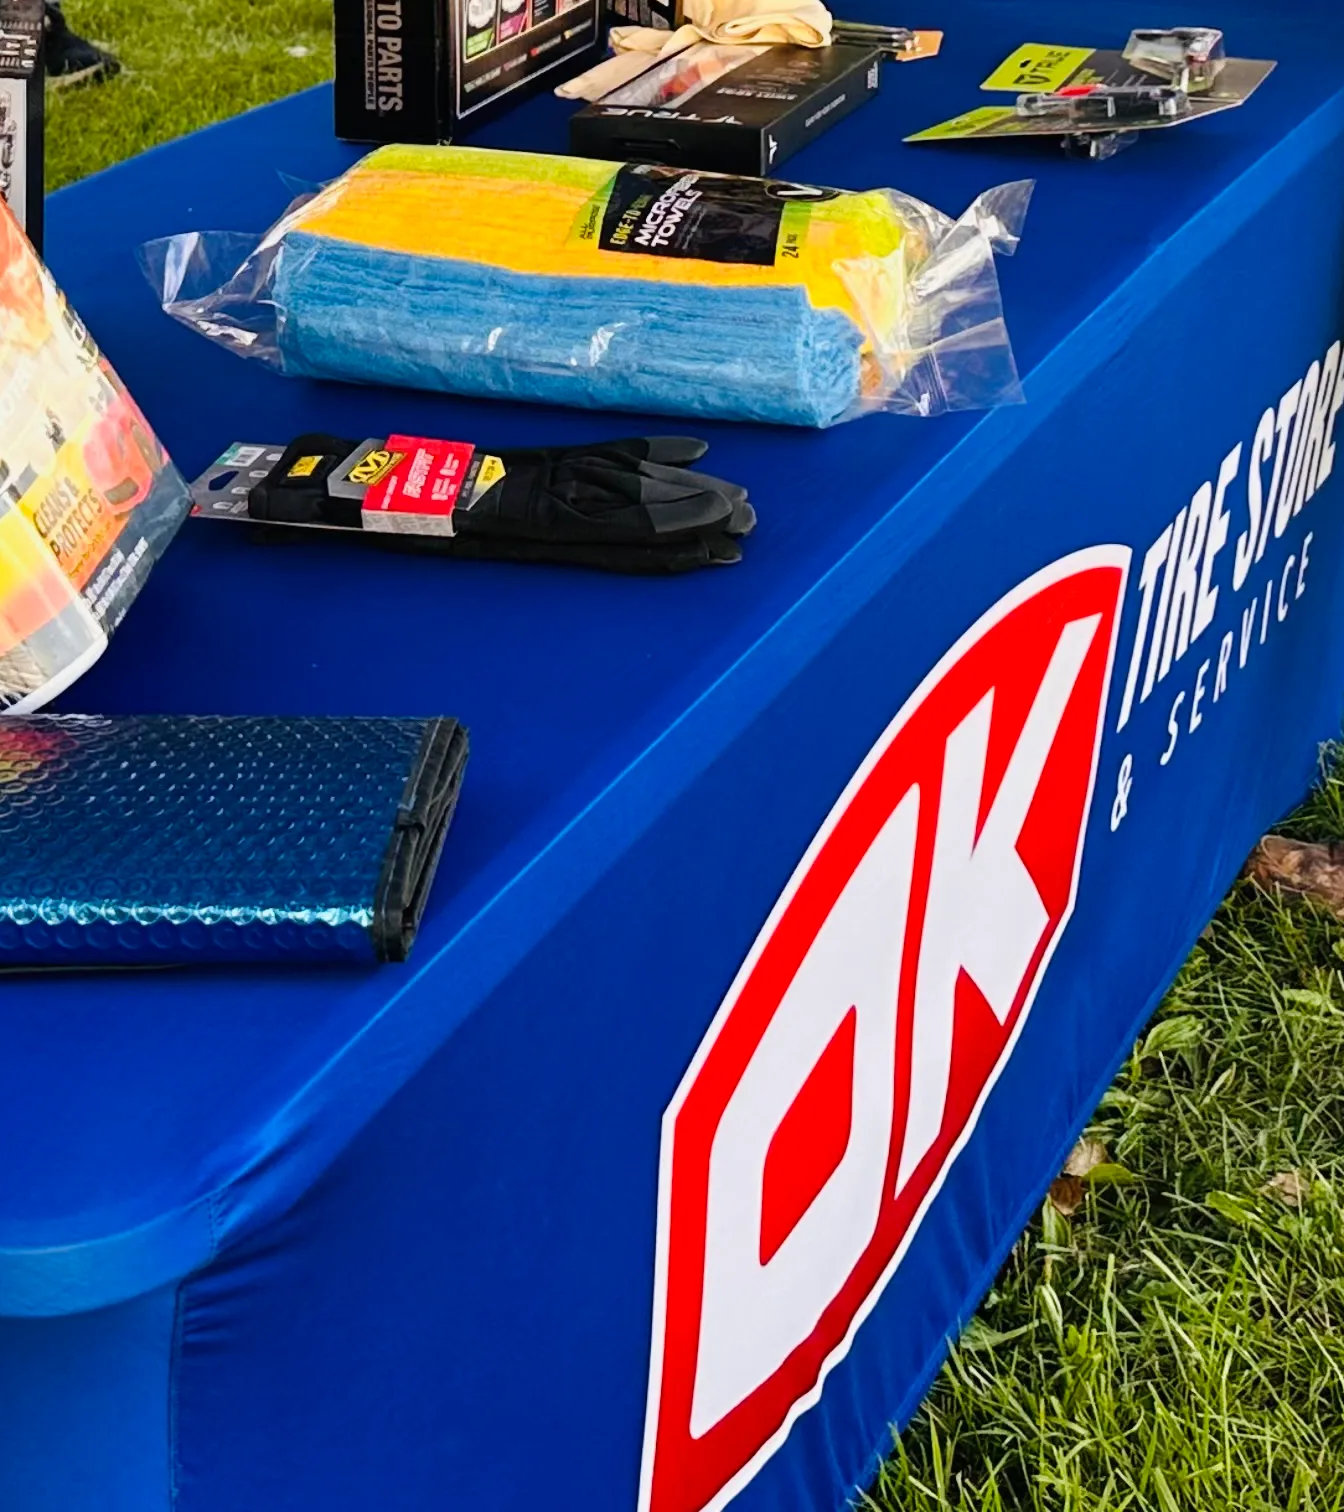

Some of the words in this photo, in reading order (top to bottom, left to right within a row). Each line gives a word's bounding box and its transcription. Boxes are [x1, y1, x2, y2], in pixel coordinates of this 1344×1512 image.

[377, 35, 404, 113] PARTS
[651, 189, 704, 249] TOWELS
[781, 244, 801, 260] 24
[49, 487, 104, 568] PROTECTS
[1116, 440, 1242, 734] TIRE
[1110, 753, 1134, 833] &
[1159, 531, 1314, 767] SERVICE
[688, 613, 1102, 1441] OK
